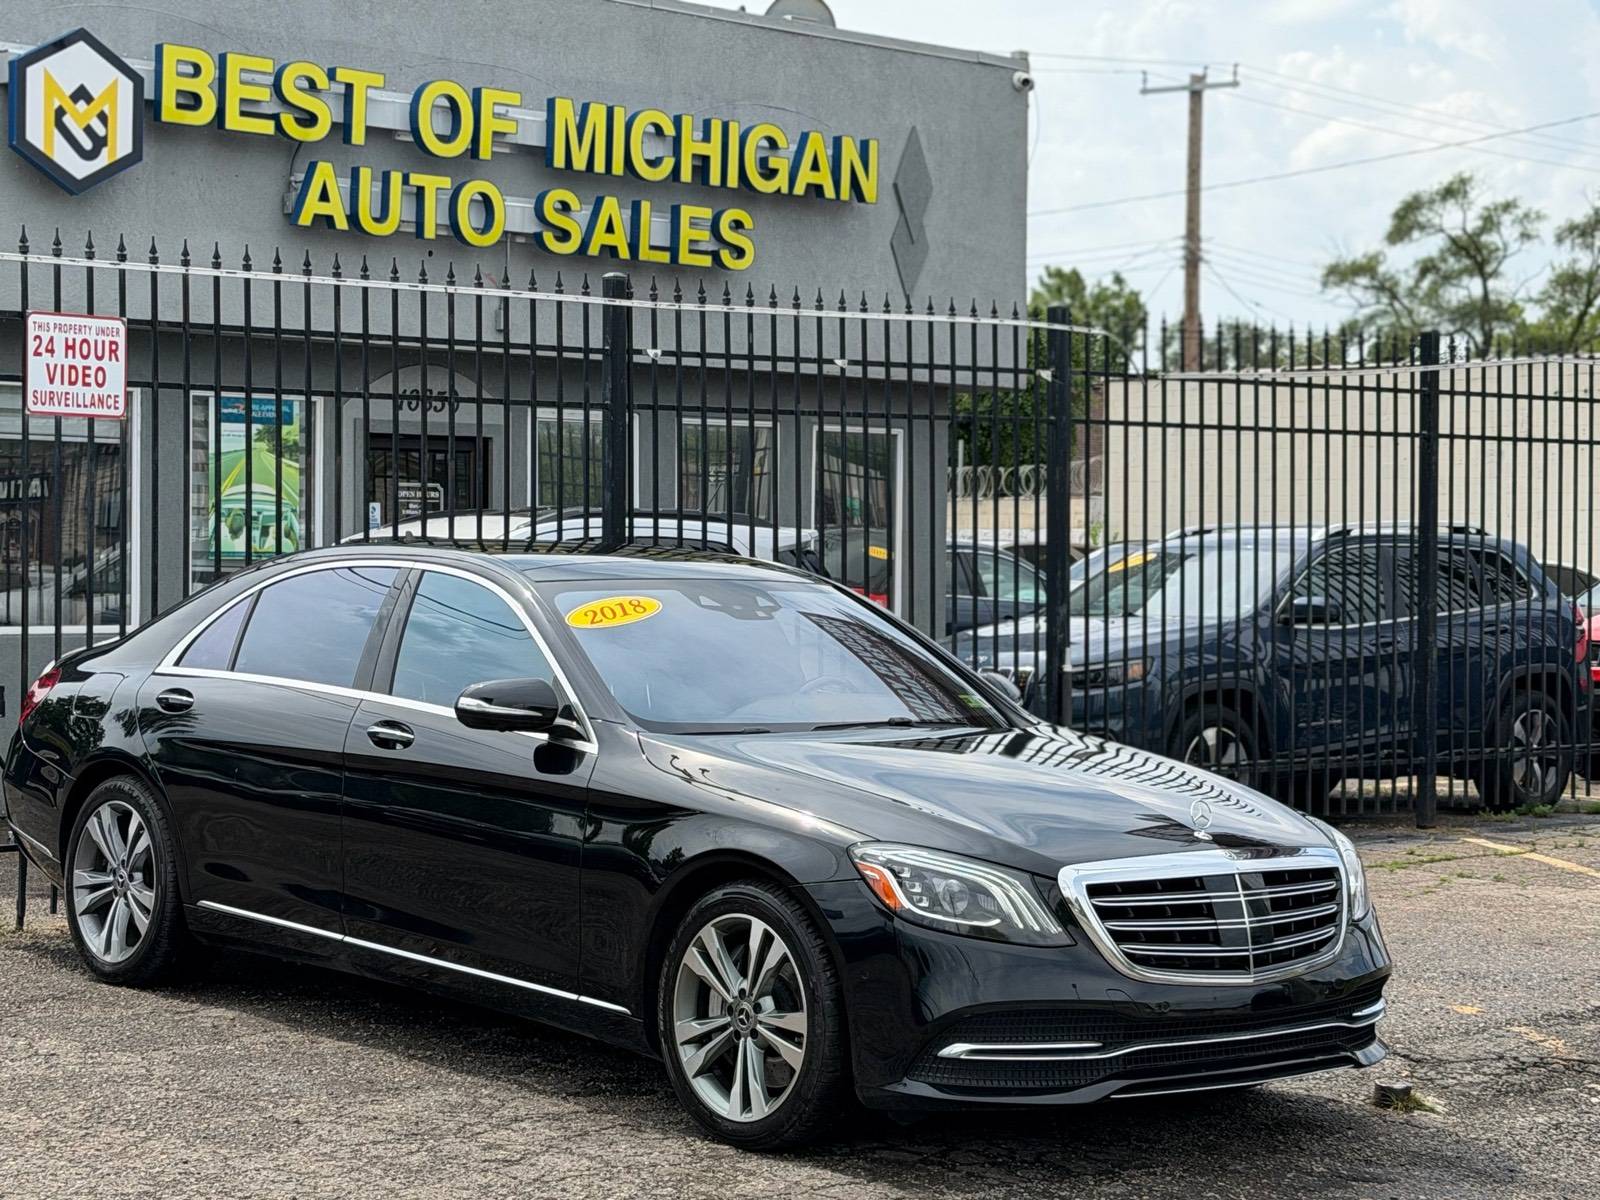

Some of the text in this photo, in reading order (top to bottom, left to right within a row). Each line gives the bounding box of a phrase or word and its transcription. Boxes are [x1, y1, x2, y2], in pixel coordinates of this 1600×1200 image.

[156, 43, 879, 204] BEST OF MICHIGAN
[293, 161, 755, 271] AUTO SALES
[32, 321, 121, 338] THIS PROPERTY UNDER
[32, 334, 120, 363] 24 HOUR
[45, 362, 107, 389] VIDEO
[32, 389, 120, 411] SURVEILLANCE
[416, 490, 440, 499] HURS
[584, 598, 648, 626] 2018
